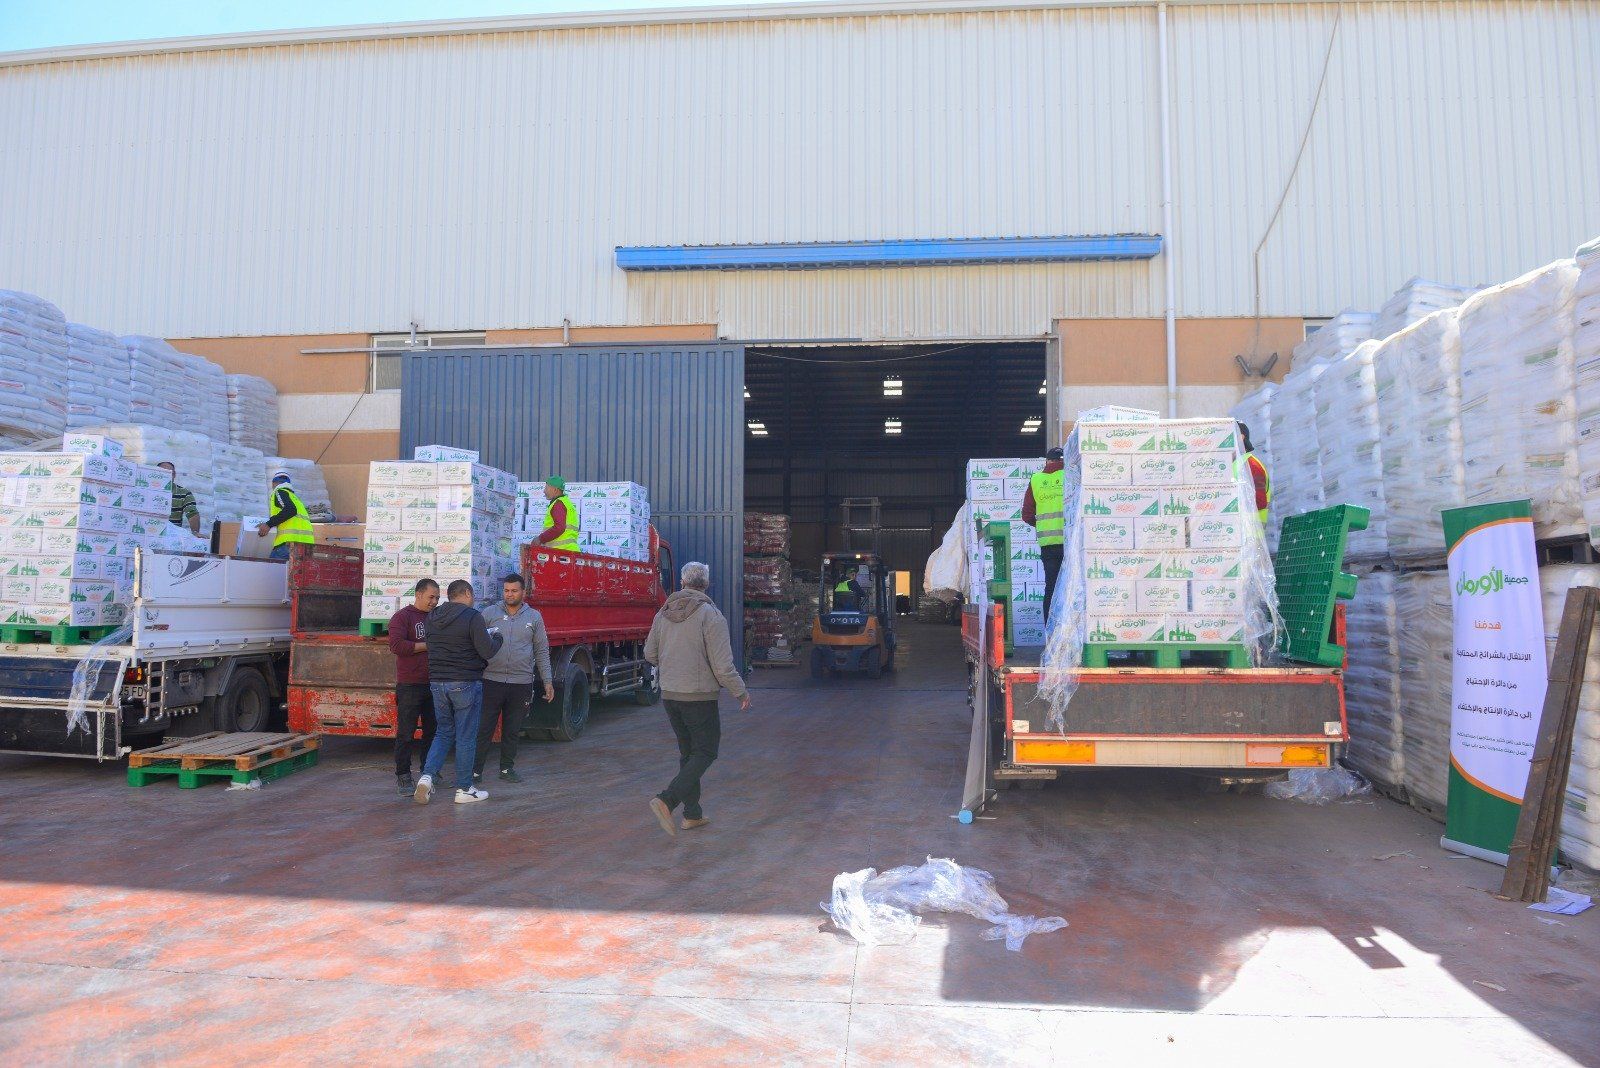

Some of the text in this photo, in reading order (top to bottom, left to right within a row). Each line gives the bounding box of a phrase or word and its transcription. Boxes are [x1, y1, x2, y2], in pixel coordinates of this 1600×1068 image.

[1456, 566, 1529, 596] جمعية الأورمان
[1475, 620, 1502, 630] هدفنا
[1456, 649, 1478, 658] المحتاجة
[1479, 650, 1506, 660] بالشرائح
[1491, 679, 1506, 688] دائرة
[1507, 681, 1518, 690] من
[1504, 708, 1518, 717] دائرة
[1520, 711, 1532, 720] إلى
